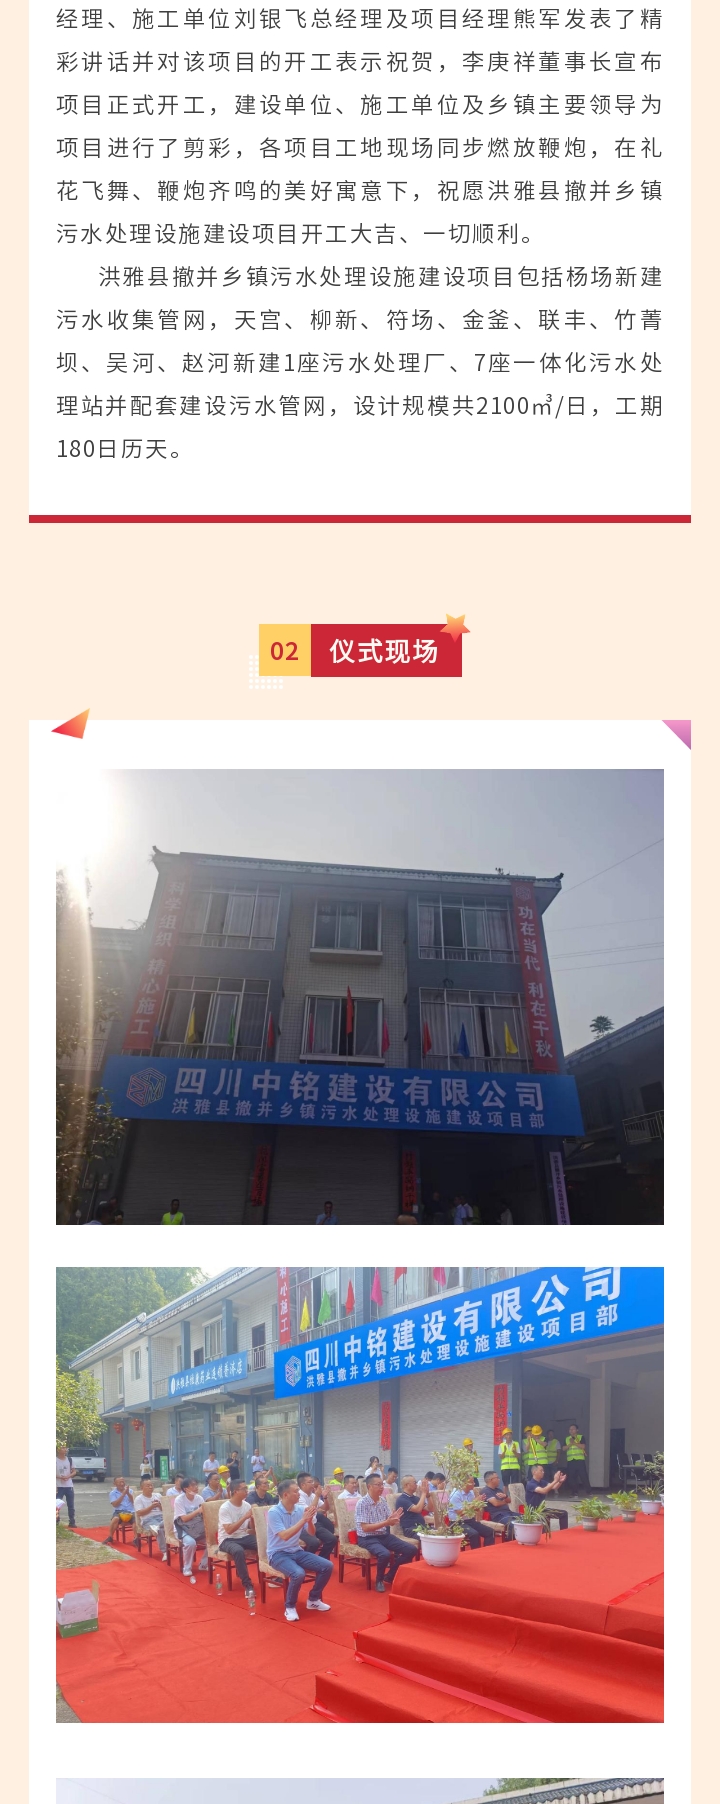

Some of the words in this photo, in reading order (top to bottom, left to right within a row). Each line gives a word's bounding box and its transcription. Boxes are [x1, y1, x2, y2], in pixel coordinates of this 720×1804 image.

[56, 8, 663, 30] 经理、施工单位刘银飞总经理及项目经理熊军发表了精
[56, 51, 662, 73] 彩讲话并对该项目的开工表示祝贺，李庚祥董事长宣布
[56, 94, 662, 116] 项目正式开工，建设单位、施工单位及乡镇主要领导为
[56, 137, 662, 159] 项目进行了剪彩，各项目工地现场同步燃放鞭炮，在礼
[56, 180, 662, 202] 花飞舞、鞭炮齐鸣的美好寓意下，祝愿洪雅县撤并乡镇
[56, 223, 533, 245] 污水处理设施建设项目开工大吉、一切顺利。
[98, 266, 662, 288] 洪雅县撤并乡镇污水处理设施建设项目包括杨场新建
[56, 352, 662, 374] 坝、吴河、赵河新建1座污水处理厂、7座一体化污水处
[57, 439, 181, 460] 180日历天。
[271, 642, 298, 660] 02
[330, 639, 437, 663] 仪式现场
[518, 905, 541, 972] 功在当代
[528, 982, 553, 1059] 利在千秋
[174, 1067, 544, 1111] 四川中铭建设有限公司
[171, 1098, 545, 1128] 洪雅县撤并乡镇污水处理设施建设项目部
[305, 1267, 621, 1373] 四川中铭建设有限公司
[306, 1304, 618, 1388] 洪雅县撤并乡镇污水处理设施建设项目部
